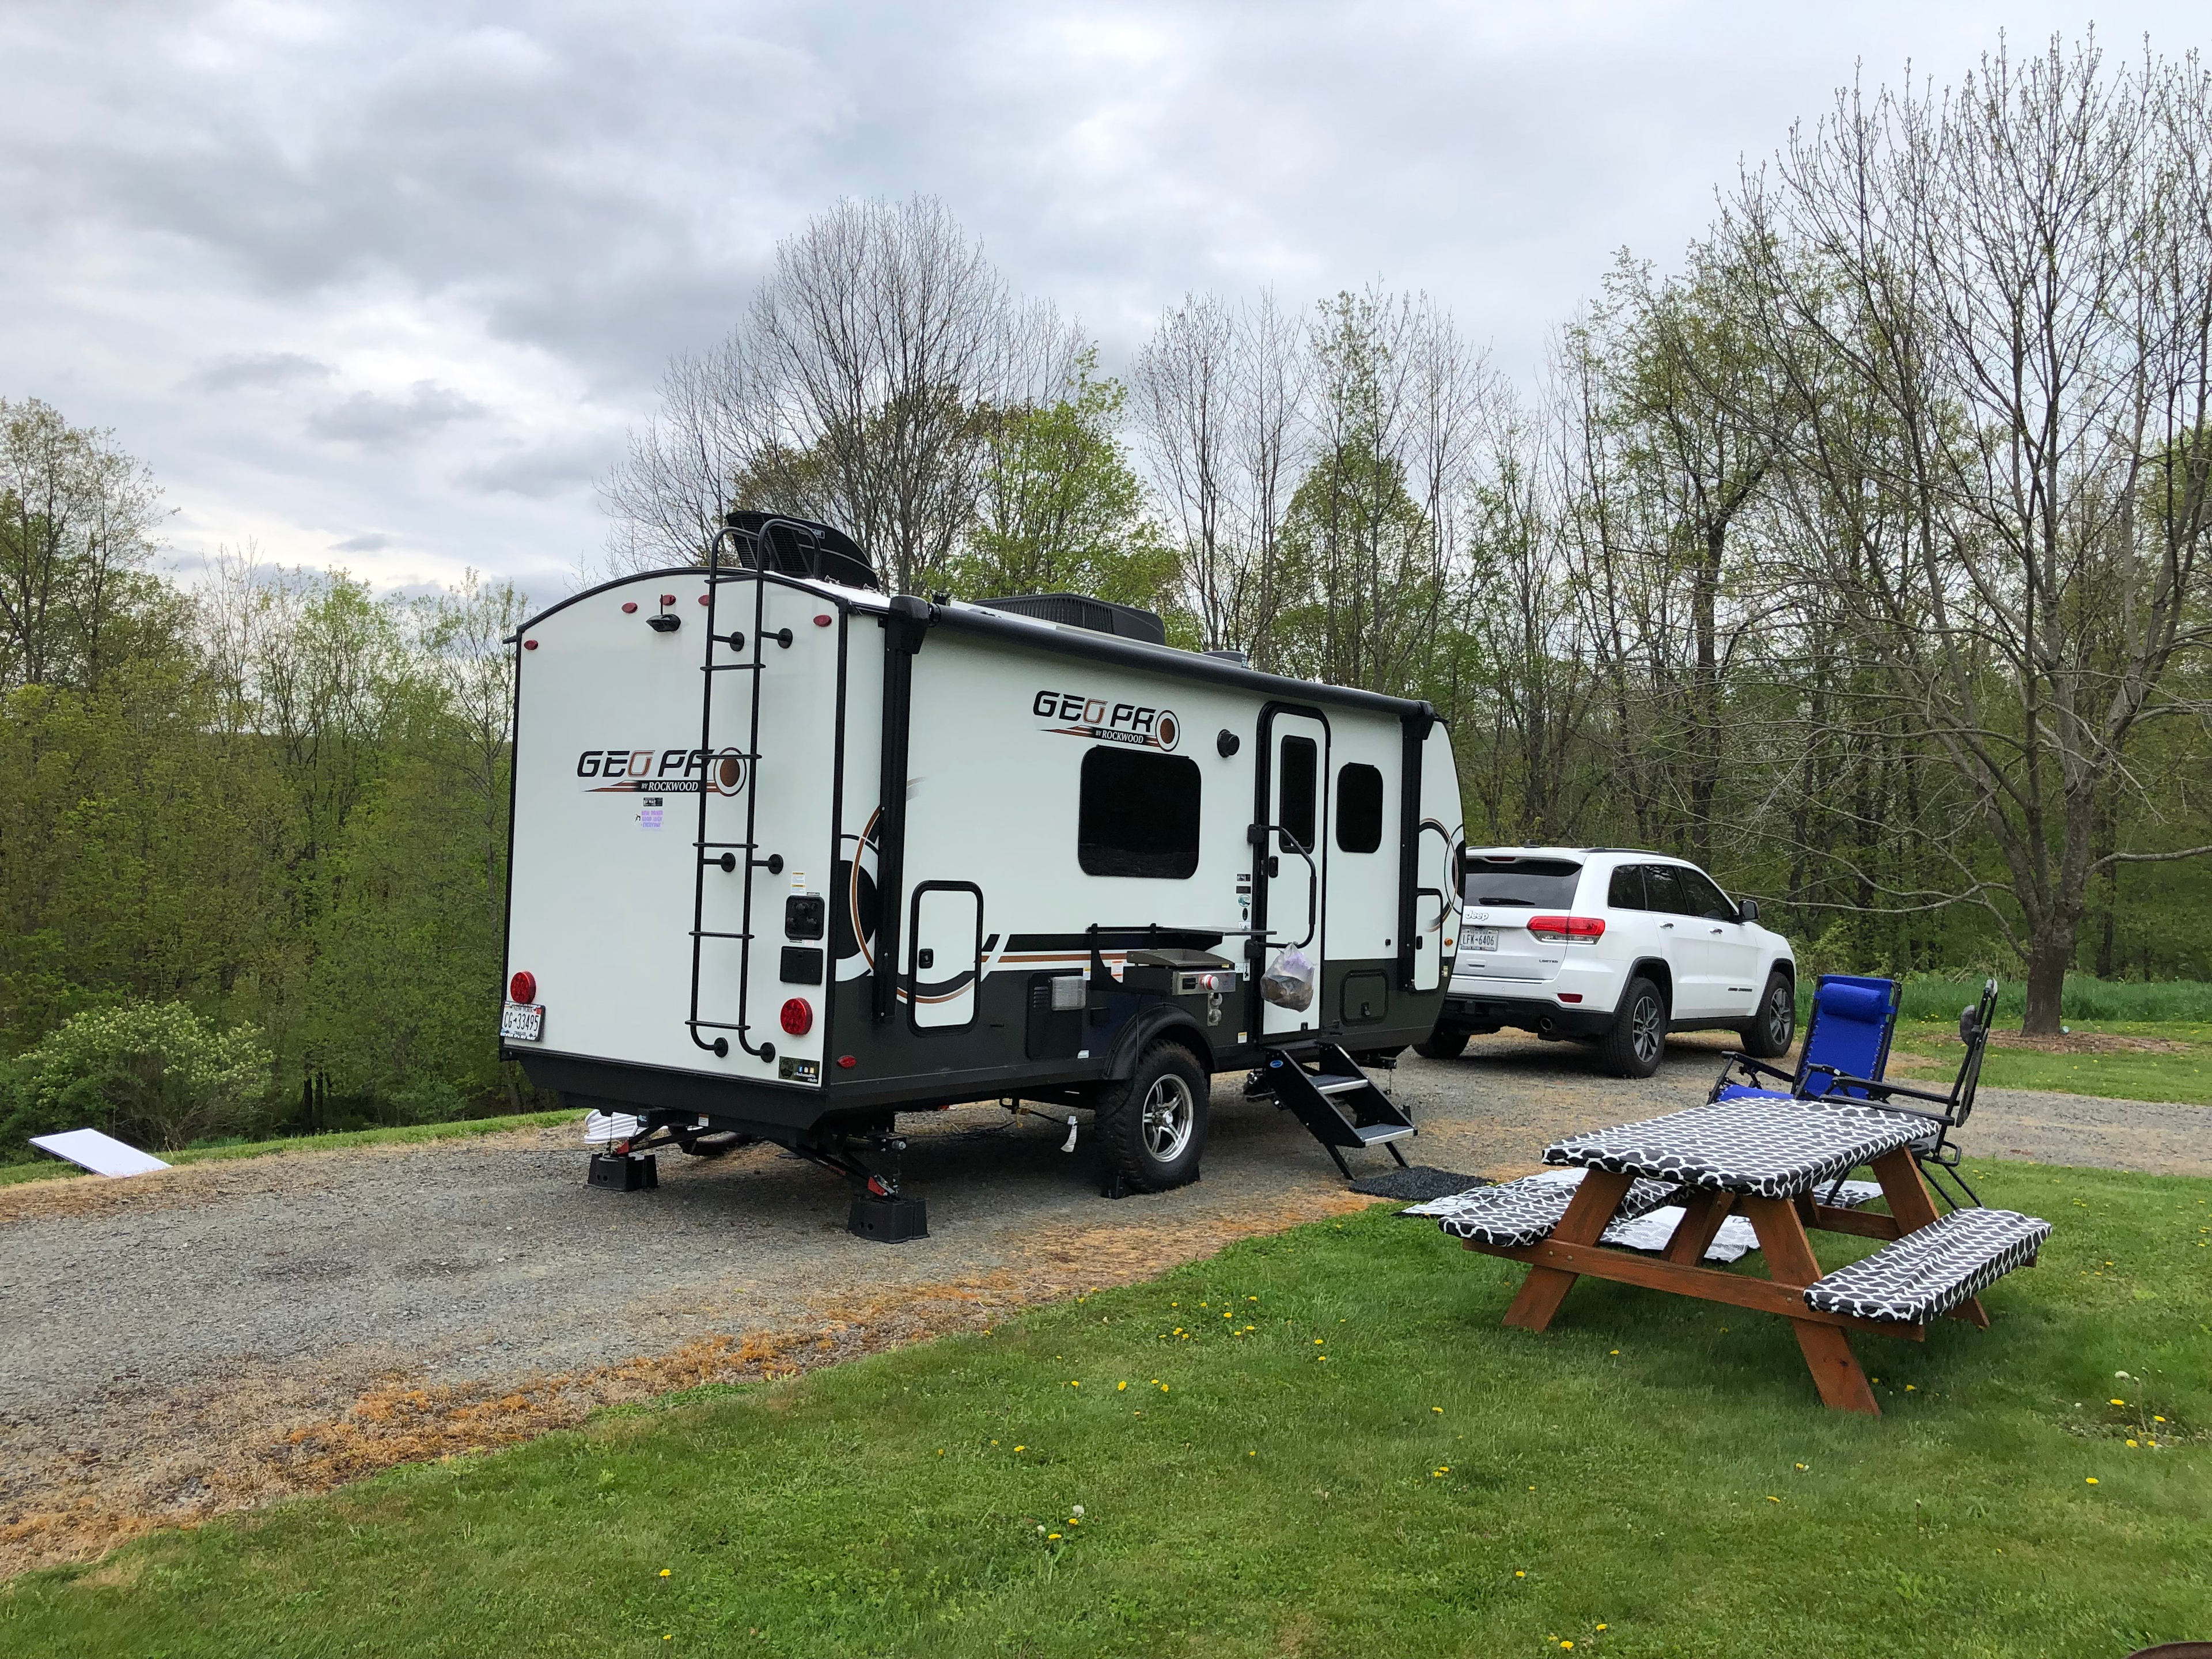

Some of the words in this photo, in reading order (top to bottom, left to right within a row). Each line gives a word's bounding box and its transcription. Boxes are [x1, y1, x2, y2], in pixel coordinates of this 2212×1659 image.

[1033, 691, 1108, 725] GEO
[1110, 703, 1180, 752] PRO
[1102, 730, 1143, 744] ROCKWOOD
[577, 750, 655, 777] GEO
[648, 782, 699, 791] ROCKWOOD
[1465, 910, 1488, 921] Jeep
